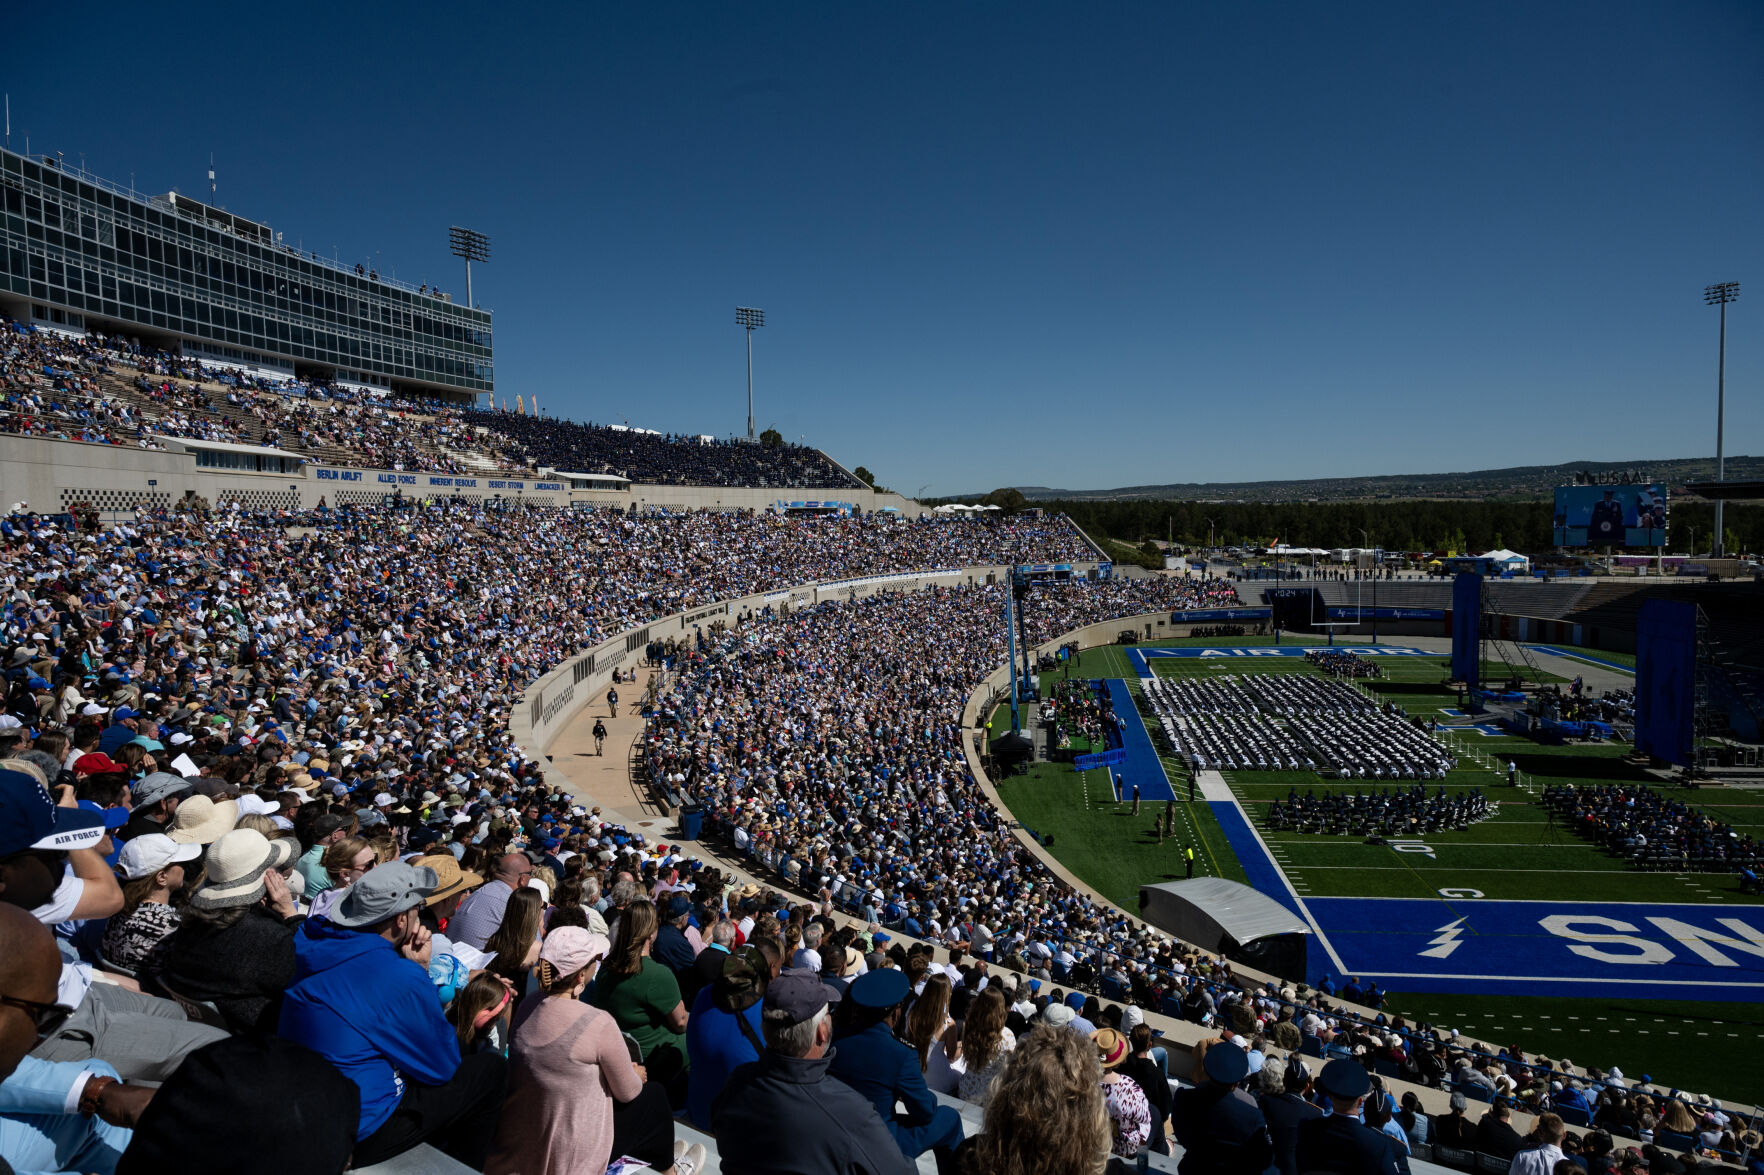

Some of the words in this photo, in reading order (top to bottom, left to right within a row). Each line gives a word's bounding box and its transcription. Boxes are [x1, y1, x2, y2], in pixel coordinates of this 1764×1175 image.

[317, 468, 339, 480] BERLIN
[341, 471, 363, 481] AIRLIFT
[378, 473, 397, 483] ALLIED
[398, 475, 416, 484] FORCE
[1599, 471, 1643, 485] USAA
[429, 477, 453, 486] INHERENT
[455, 478, 477, 487] RESOLVE
[488, 480, 507, 489] DESERT
[508, 481, 524, 489] STORM
[55, 836, 71, 844] AIR
[73, 830, 99, 841] FORCE
